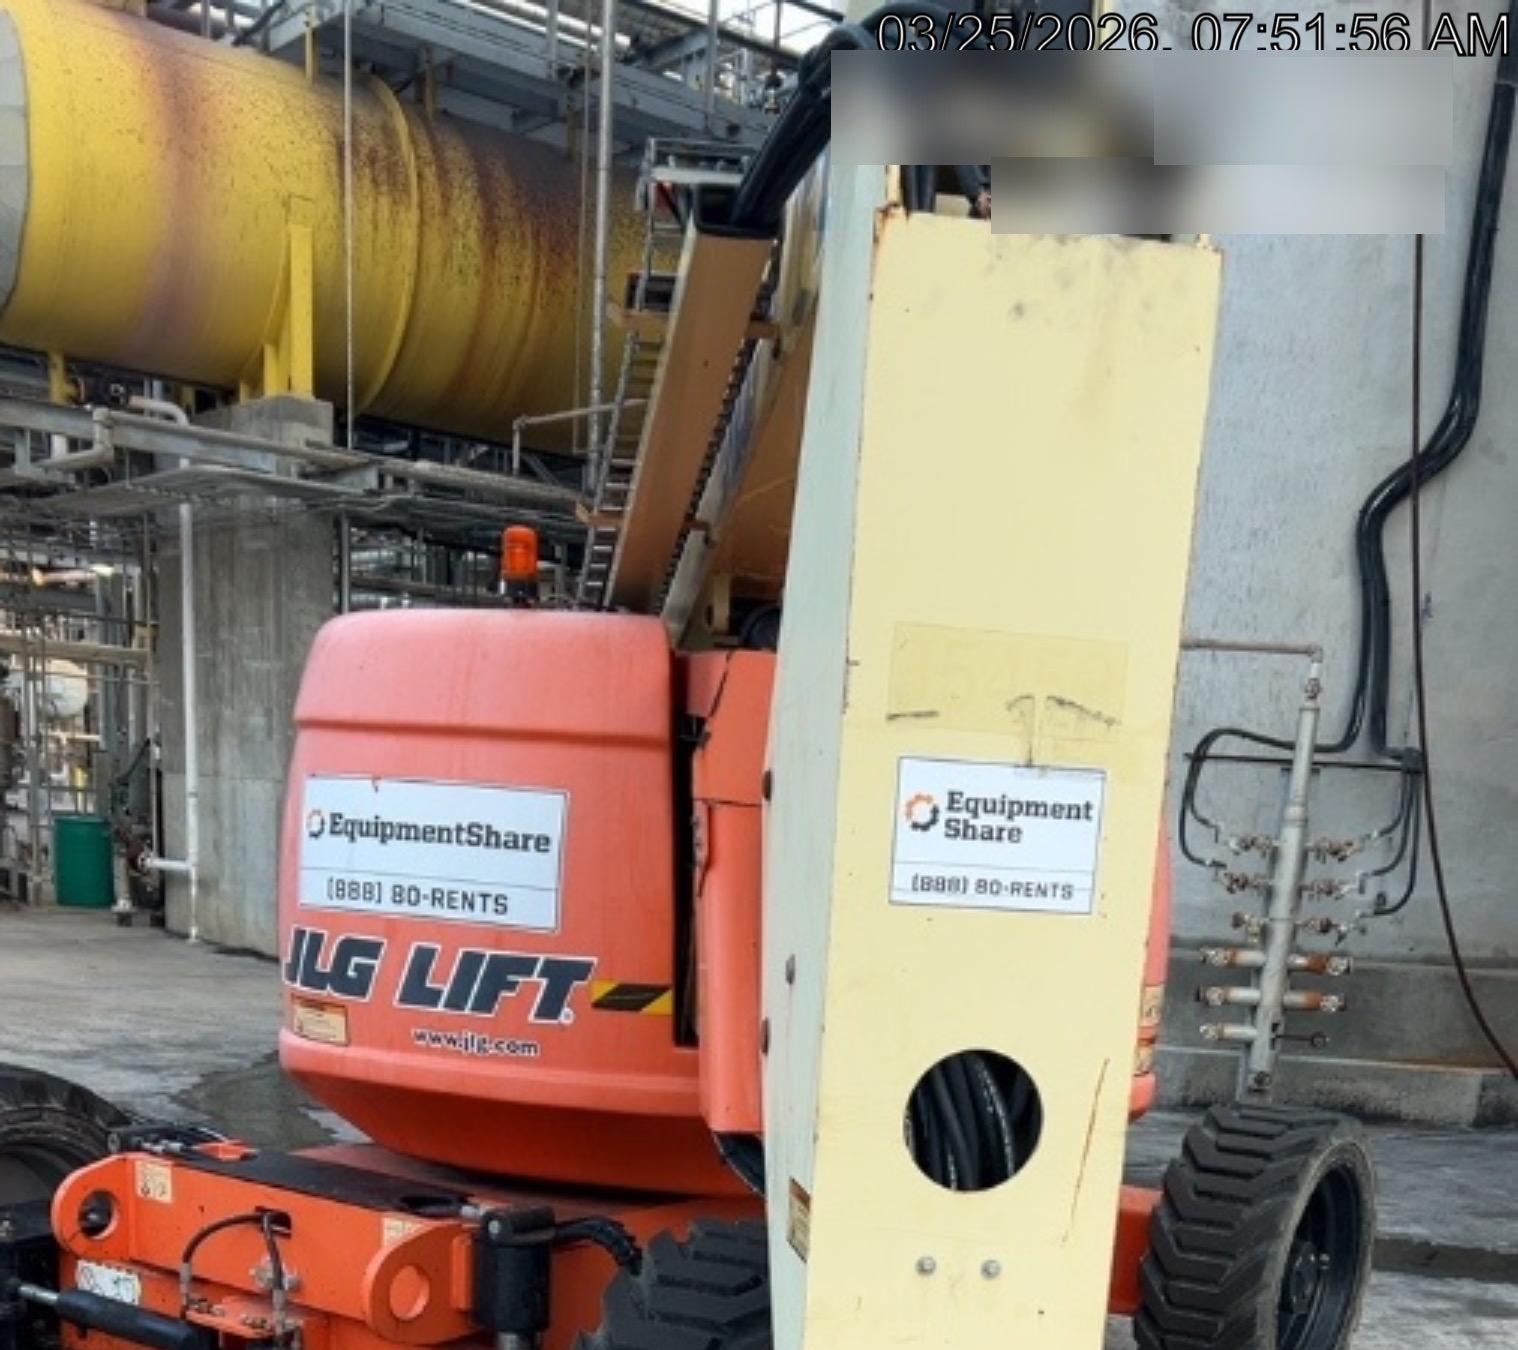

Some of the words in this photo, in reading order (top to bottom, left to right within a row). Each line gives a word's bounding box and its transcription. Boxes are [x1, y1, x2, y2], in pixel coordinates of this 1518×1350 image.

[946, 790, 1093, 821] Equipment
[329, 812, 551, 852] EquipmentShare
[944, 817, 1023, 843] Share
[391, 883, 510, 915] 80-RENTS
[974, 878, 1074, 900] 80-RENTS
[282, 926, 388, 1002] JLG
[411, 1028, 541, 1057] www.jlg.com
